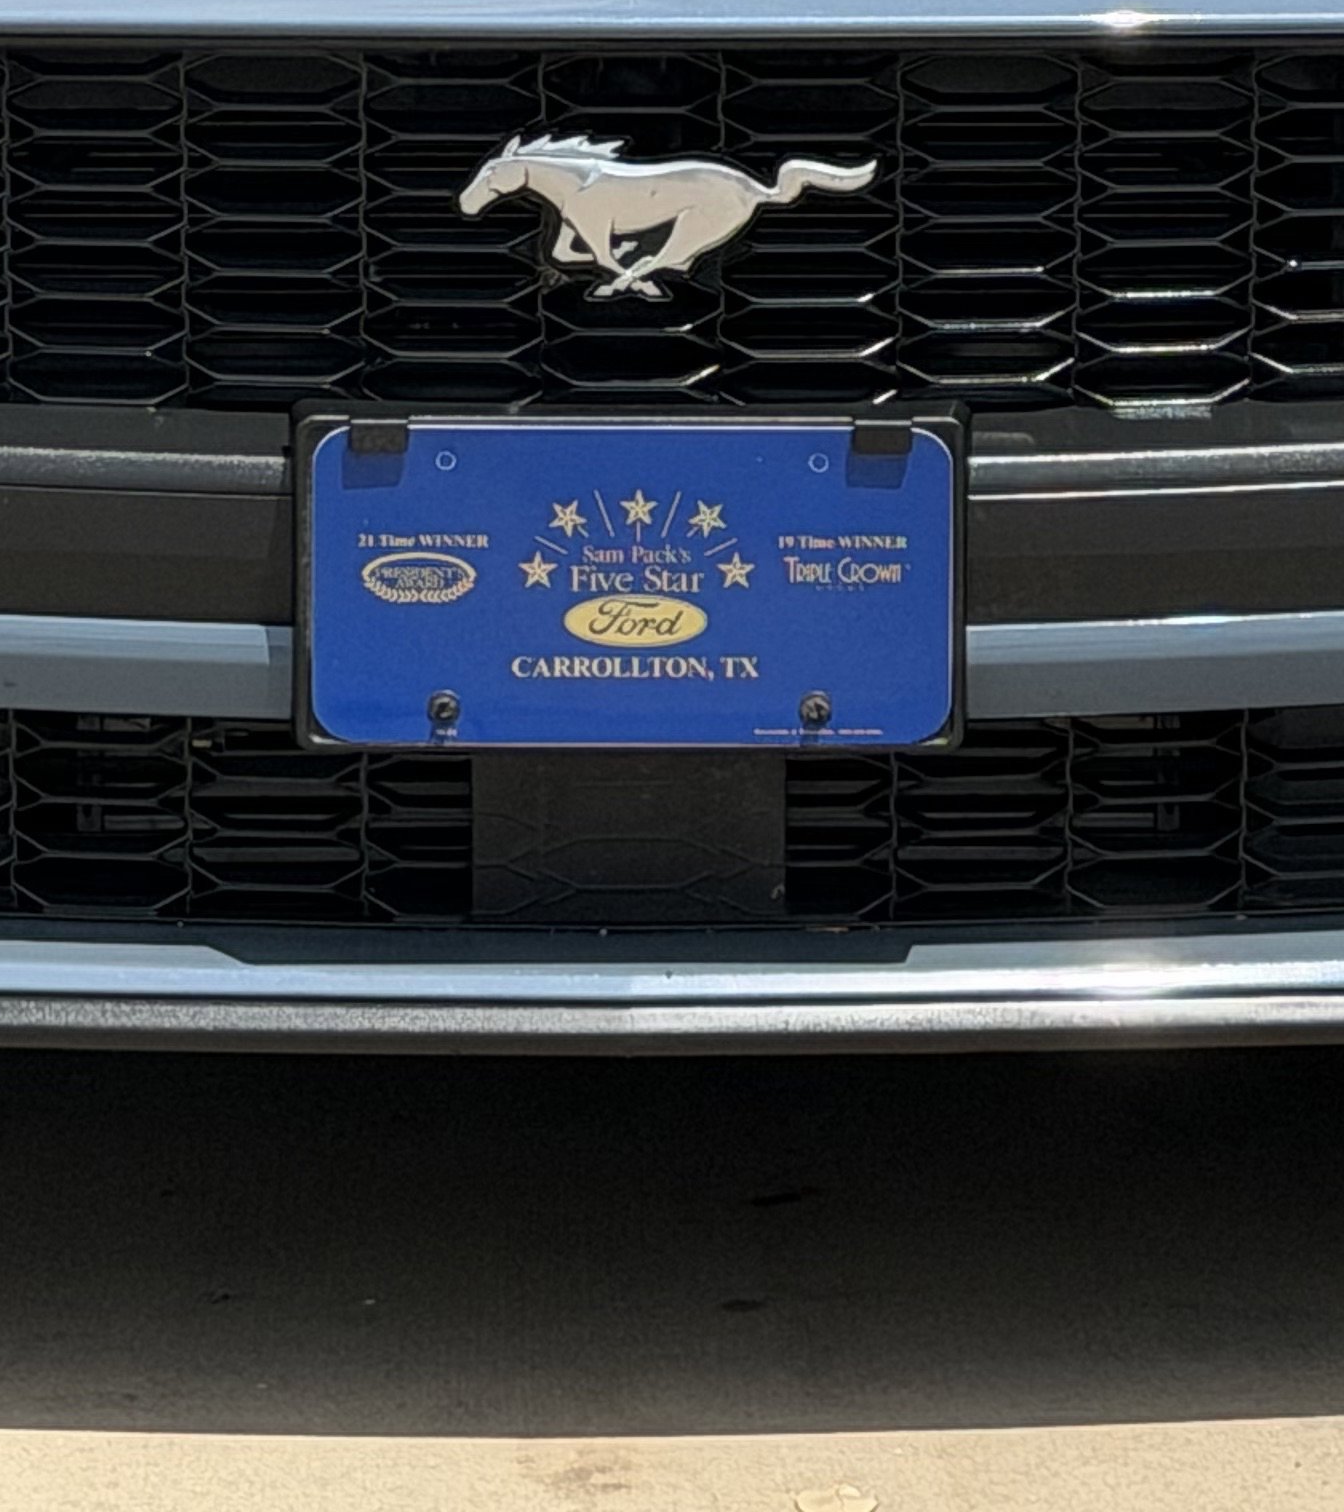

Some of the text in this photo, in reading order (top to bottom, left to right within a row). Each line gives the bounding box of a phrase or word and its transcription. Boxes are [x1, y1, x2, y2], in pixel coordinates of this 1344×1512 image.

[358, 533, 489, 548] 21 Time WINNER
[778, 535, 908, 550] 19 Time WINNER
[582, 543, 692, 565] Sam Pack's
[569, 563, 705, 593] Five Star
[588, 598, 685, 636] Ford
[511, 655, 760, 681] CARROLLTON, TX
